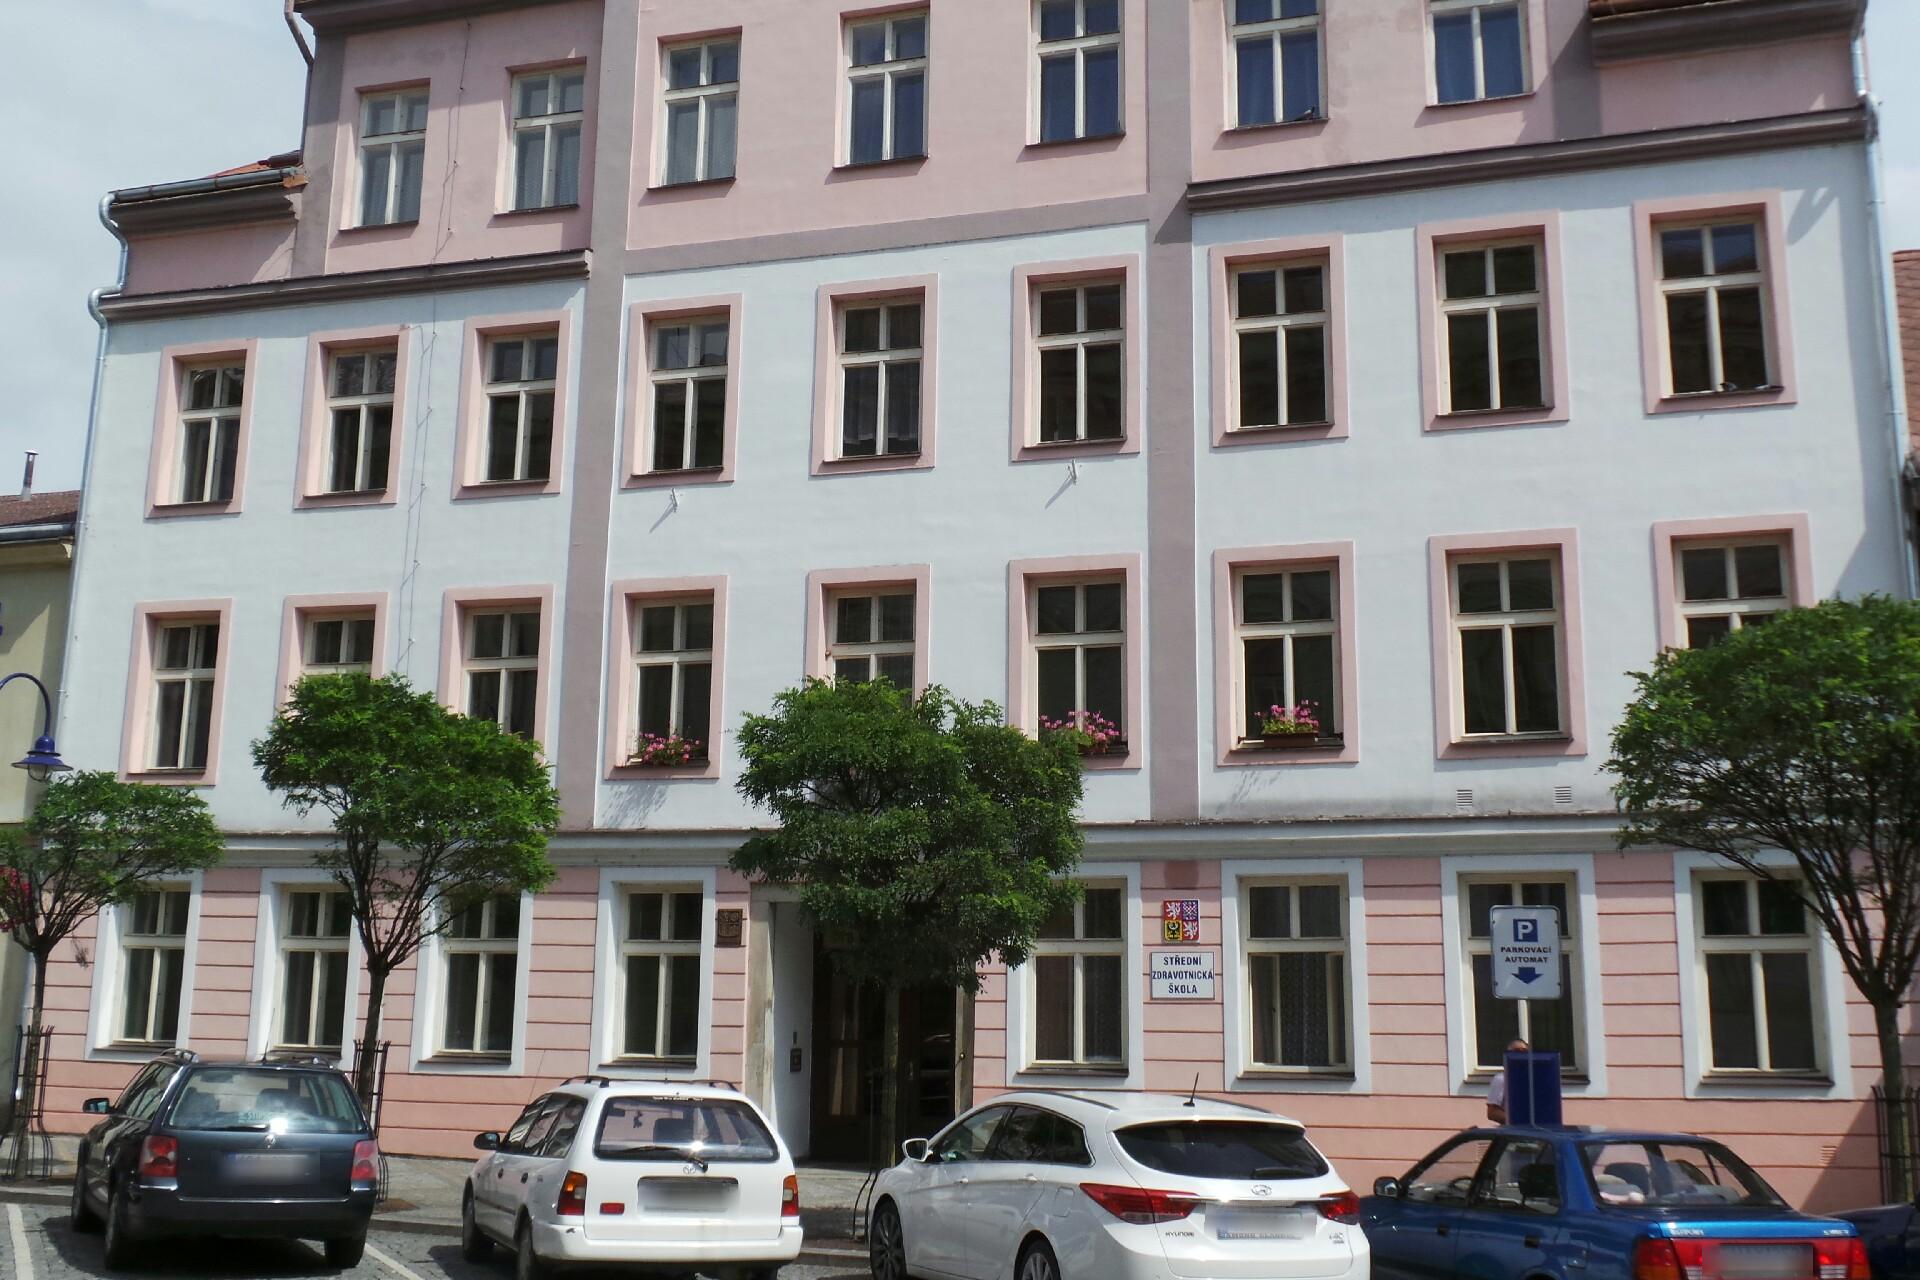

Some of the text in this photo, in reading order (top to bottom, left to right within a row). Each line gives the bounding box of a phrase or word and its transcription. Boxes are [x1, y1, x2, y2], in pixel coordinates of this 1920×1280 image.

[1517, 921, 1534, 940] P
[1500, 945, 1552, 954] PARKOVACÍ
[1163, 954, 1202, 966] STŘEDNÍ
[1152, 969, 1214, 980] ZDRAVOTNICKÁ
[1168, 983, 1198, 994] ŠKOLA
